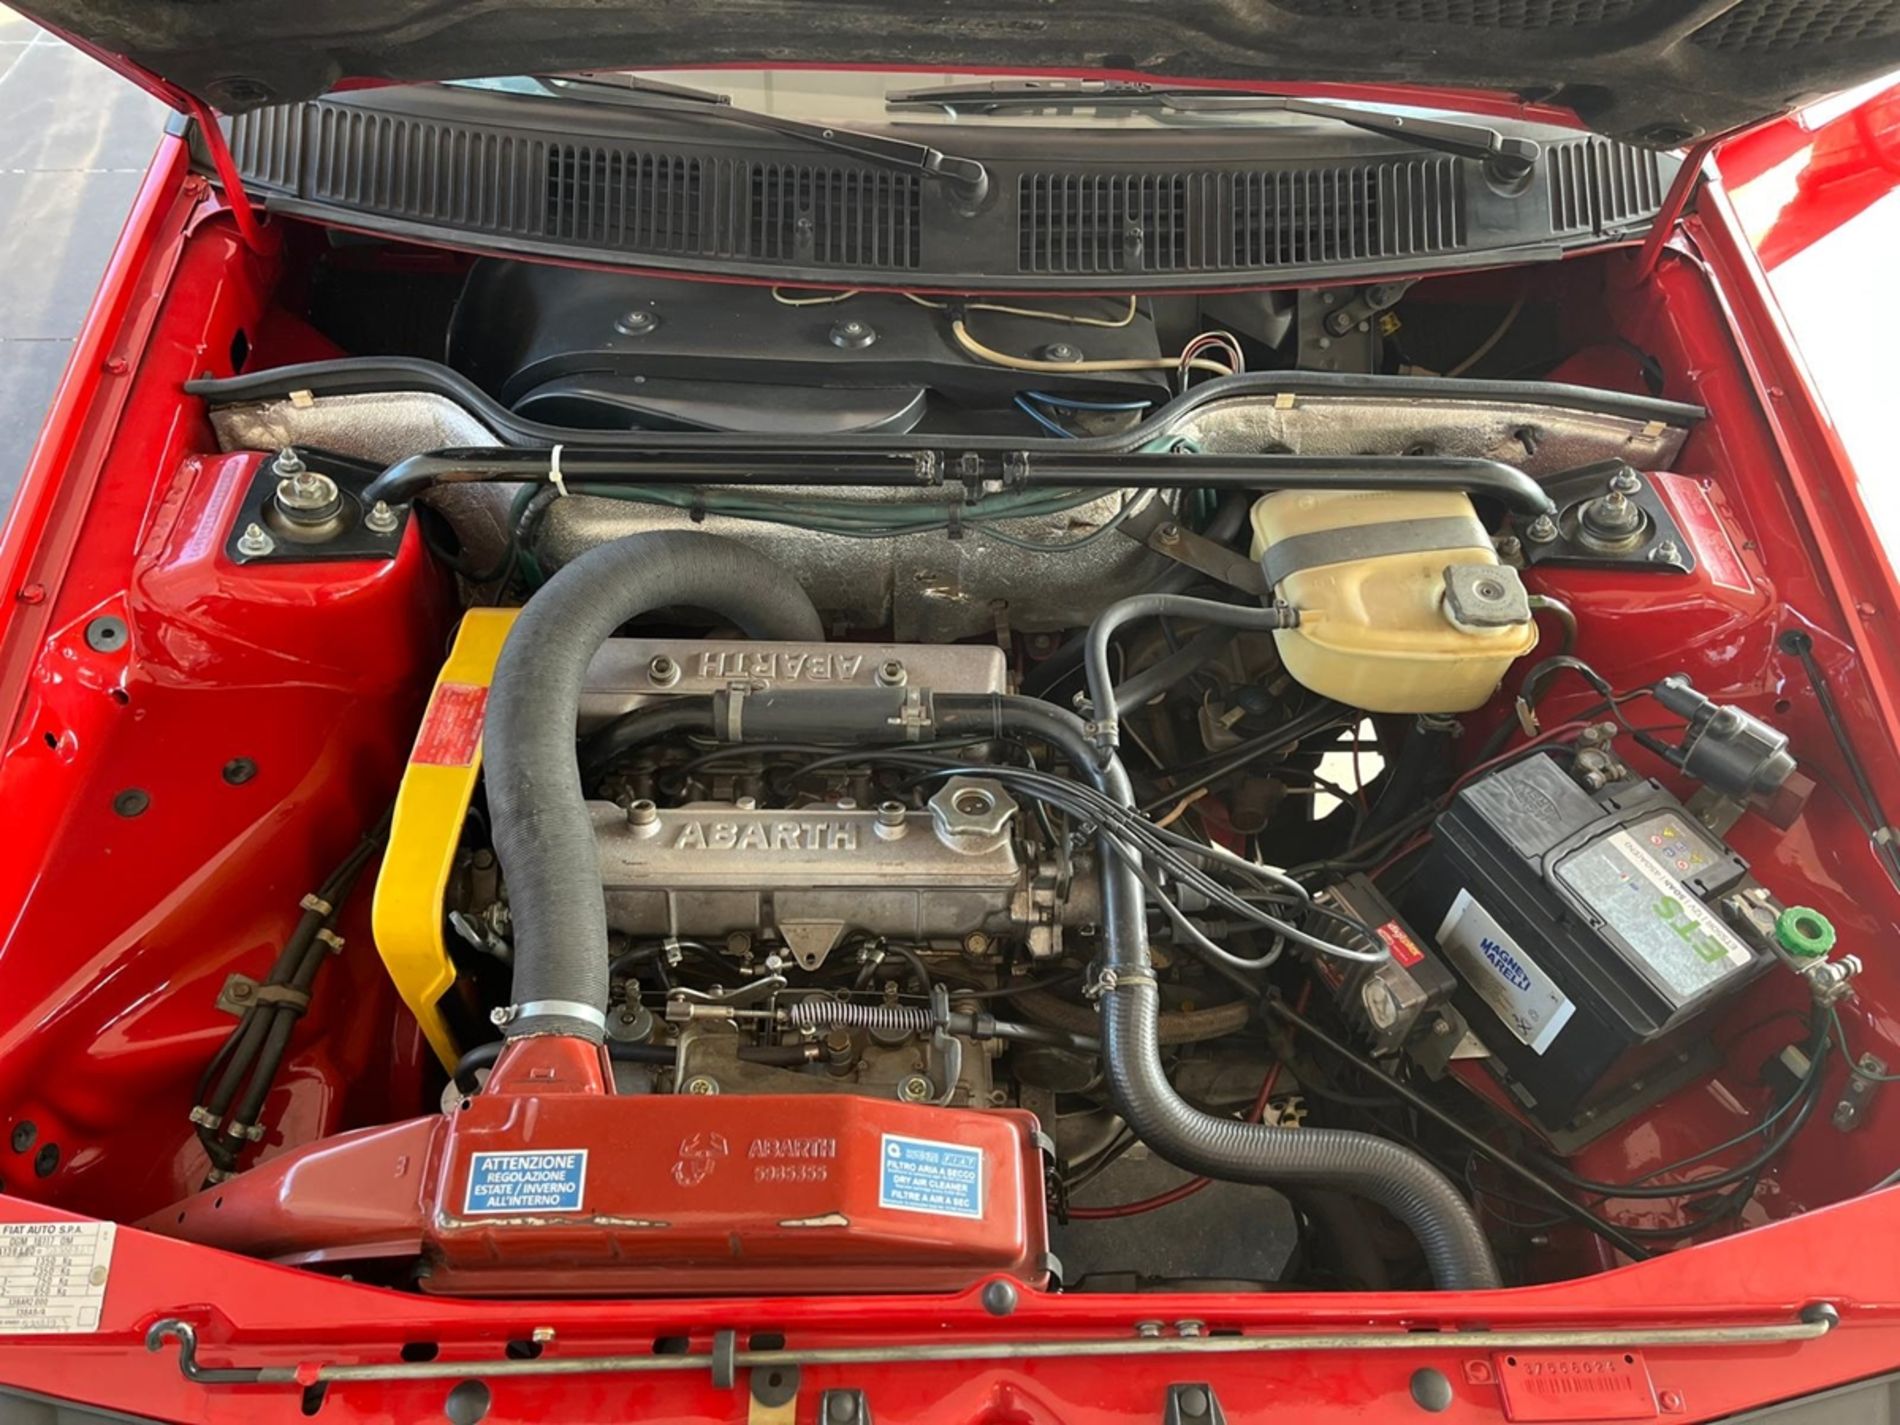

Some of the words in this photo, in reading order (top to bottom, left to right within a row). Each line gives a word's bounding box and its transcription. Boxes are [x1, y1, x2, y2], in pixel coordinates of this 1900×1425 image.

[699, 653, 862, 680] ABARTH
[674, 820, 858, 850] ABARTH
[1653, 896, 1728, 963] ETS
[1480, 938, 1529, 984] MAGNETI
[1483, 944, 1531, 991] MARELLI
[748, 1138, 836, 1158] ABARTH
[481, 1155, 576, 1171] ATTENZIONE
[887, 1160, 916, 1171] FILTRO
[918, 1164, 938, 1175] ARIA
[939, 1167, 945, 1176] A
[946, 1168, 976, 1180] SECCO
[487, 1170, 566, 1183] REGOLAZIONE
[893, 1174, 911, 1186] DRY
[912, 1177, 927, 1187] AIR
[929, 1179, 968, 1192] CLEANER
[474, 1183, 513, 1196] ESTATE
[514, 1183, 522, 1196] /
[523, 1182, 576, 1194] INVERNO
[891, 1189, 920, 1201] FILTRE
[921, 1193, 928, 1202] A
[929, 1194, 945, 1203] AIR
[945, 1196, 952, 1205] A
[953, 1197, 970, 1208] SEC
[486, 1194, 560, 1207] ALL'INTERNO
[3, 1226, 26, 1234] FIAT
[27, 1225, 56, 1234] AUTO
